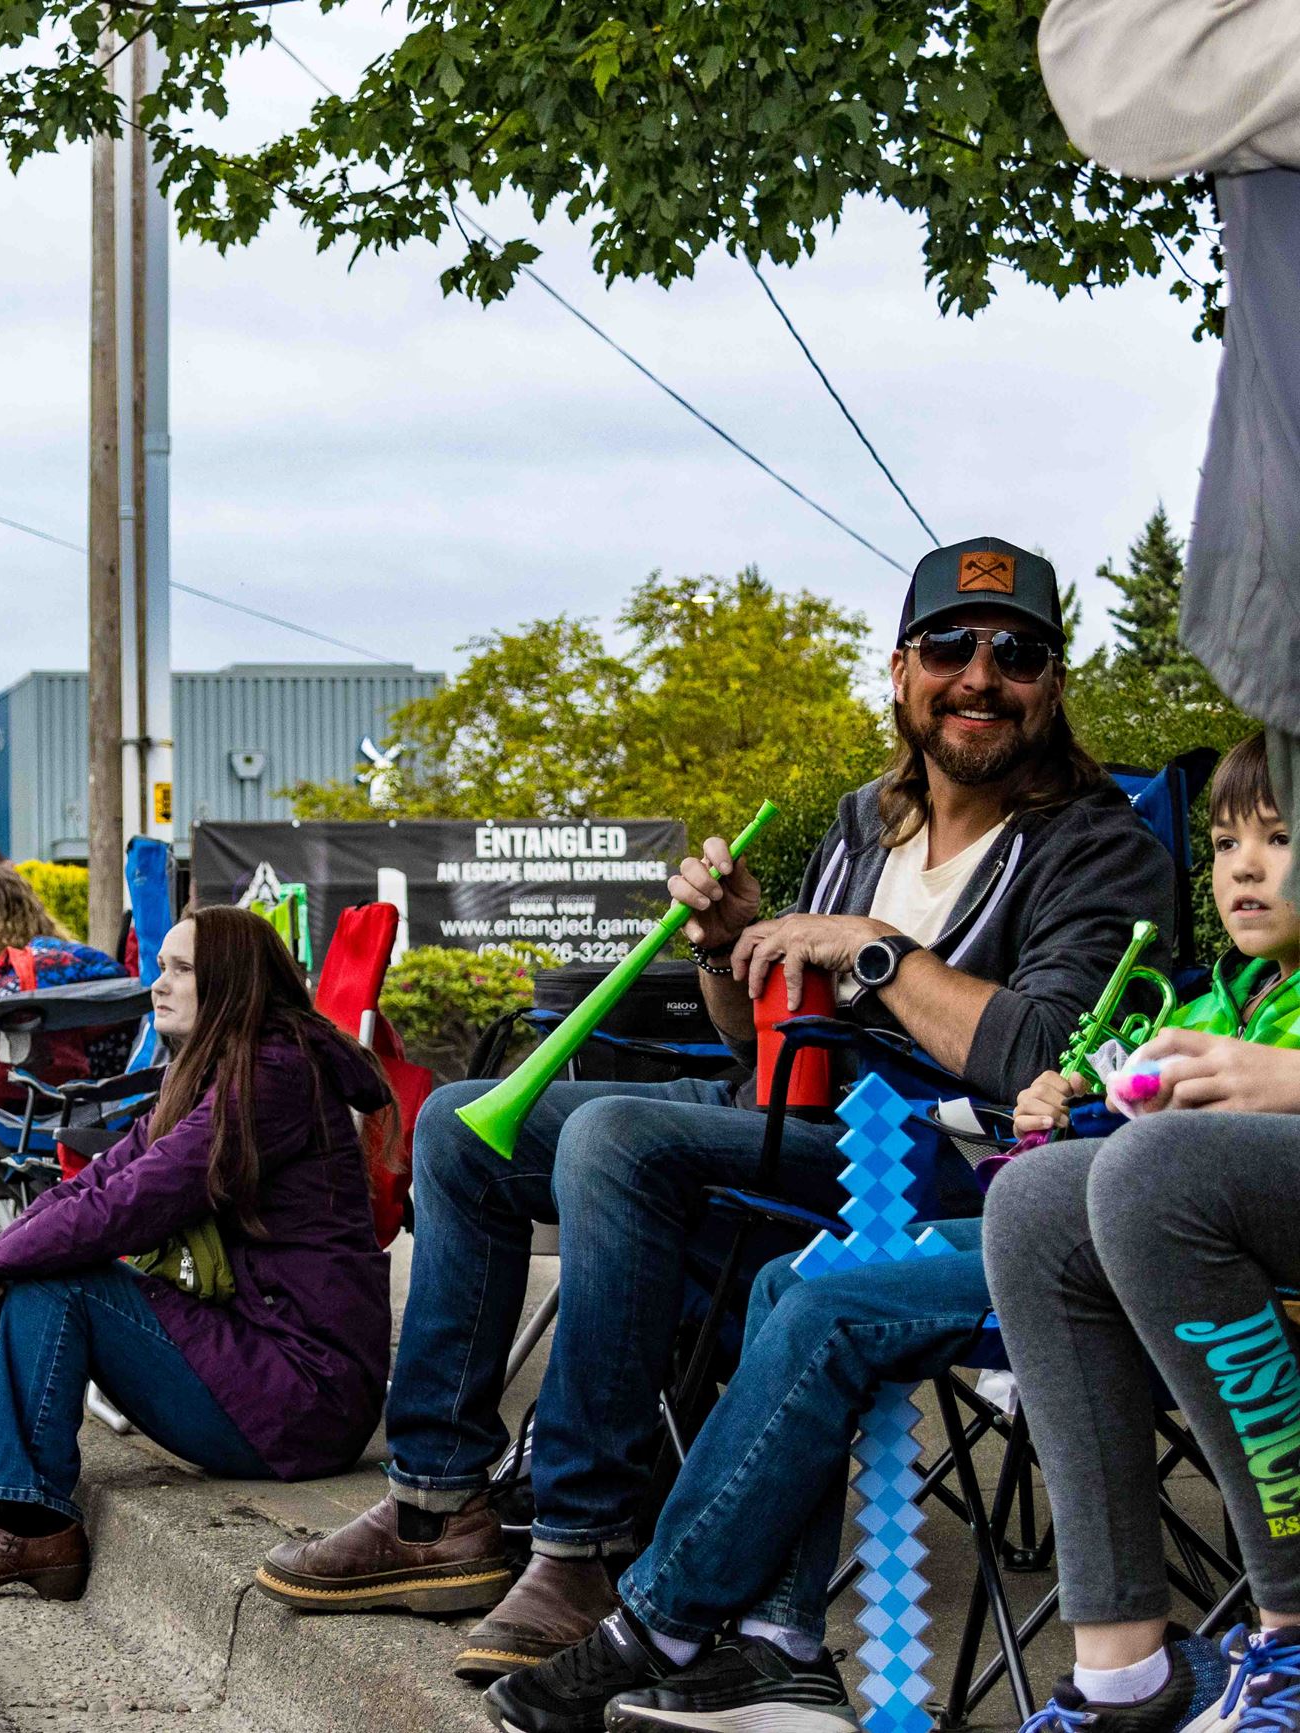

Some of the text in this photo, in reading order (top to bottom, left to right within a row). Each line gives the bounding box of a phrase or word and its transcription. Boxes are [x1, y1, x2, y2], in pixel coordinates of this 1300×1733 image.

[475, 826, 627, 859] ENTANGLED
[436, 860, 668, 883] AN ESCAPE ROOM EXPERIENCE
[666, 1001, 698, 1010] IGLOO
[1266, 1513, 1300, 1538] ES
